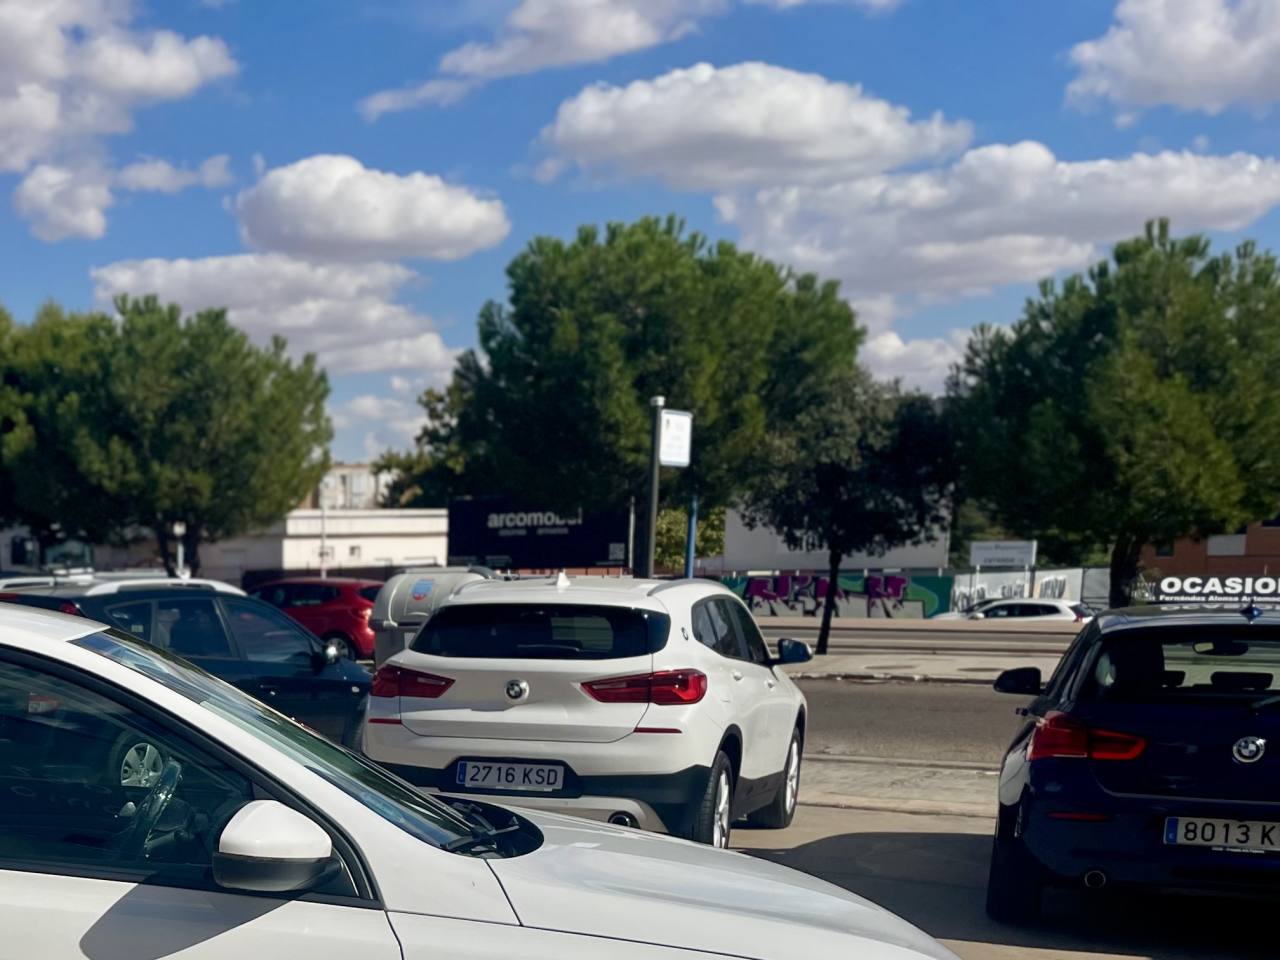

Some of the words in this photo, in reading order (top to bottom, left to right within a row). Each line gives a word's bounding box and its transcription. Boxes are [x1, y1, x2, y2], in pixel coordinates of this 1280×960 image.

[1160, 576, 1280, 594] OCASIO
[469, 765, 515, 783] 2716
[522, 767, 558, 785] KSD
[1184, 821, 1250, 844] 8013
[1261, 824, 1276, 846] K
